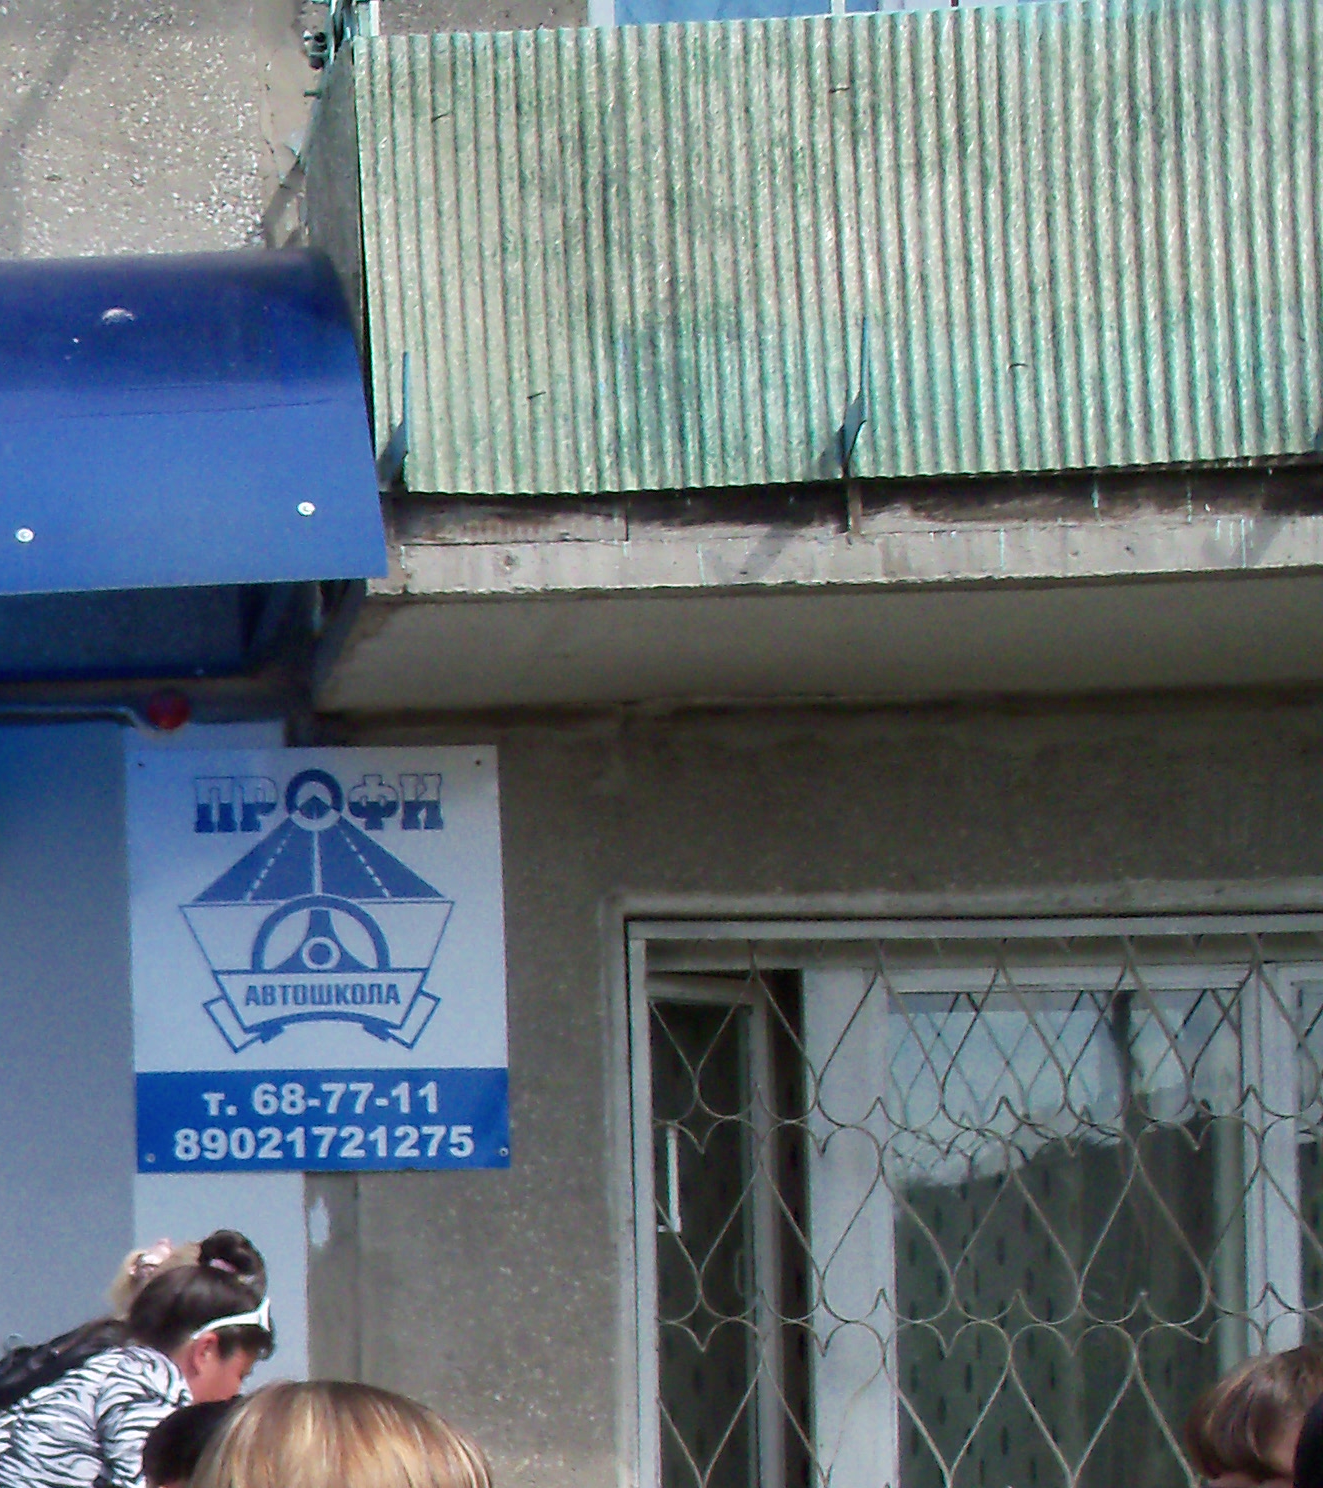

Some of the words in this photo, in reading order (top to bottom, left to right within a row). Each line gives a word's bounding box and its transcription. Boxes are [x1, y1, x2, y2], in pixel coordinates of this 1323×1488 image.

[194, 768, 445, 833] ПРОФИ
[244, 982, 402, 1008] АВТОШКОЛА
[251, 1080, 440, 1116] 68-77-11
[173, 1124, 476, 1161] 89021721275
